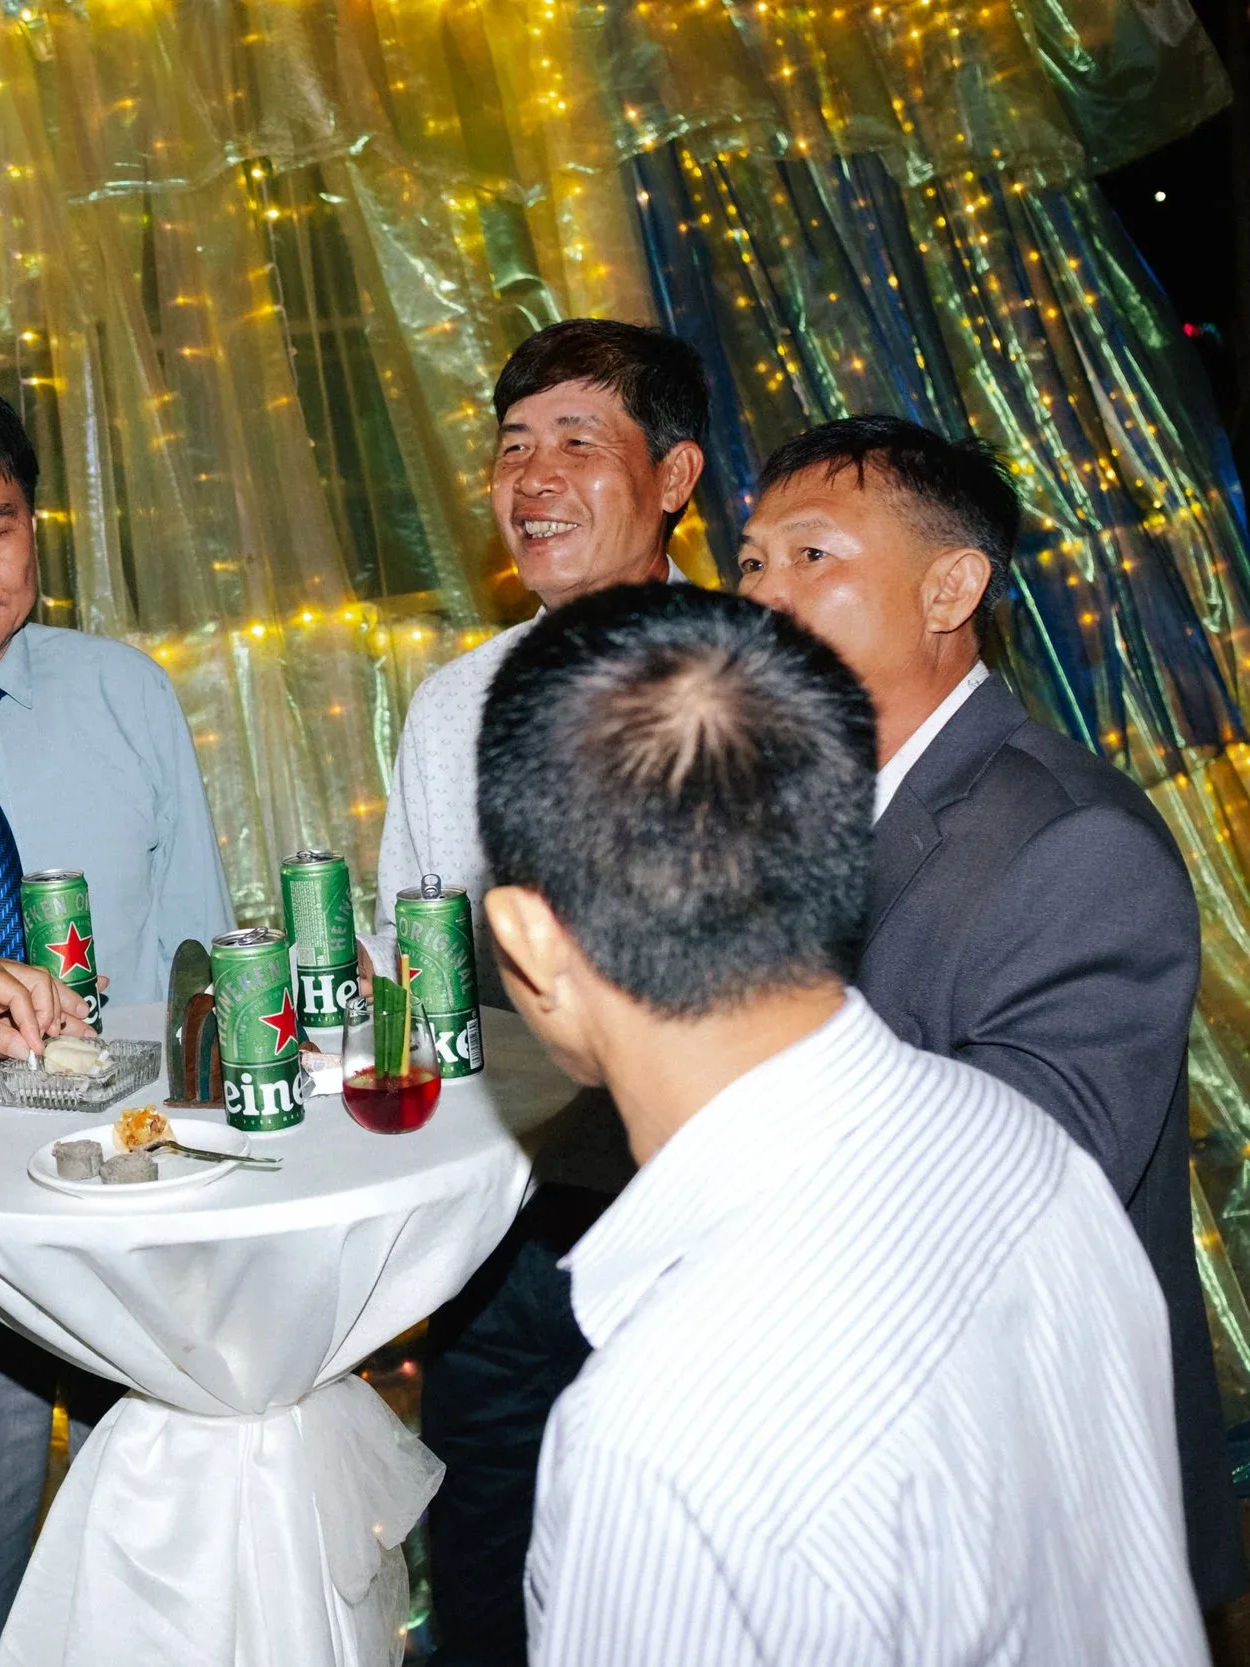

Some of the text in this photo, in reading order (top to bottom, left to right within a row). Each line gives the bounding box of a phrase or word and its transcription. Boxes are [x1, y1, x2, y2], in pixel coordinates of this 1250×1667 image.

[300, 974, 360, 1014] He
[398, 916, 472, 995] ORIGINAL
[214, 958, 282, 1047] HEINEKEN
